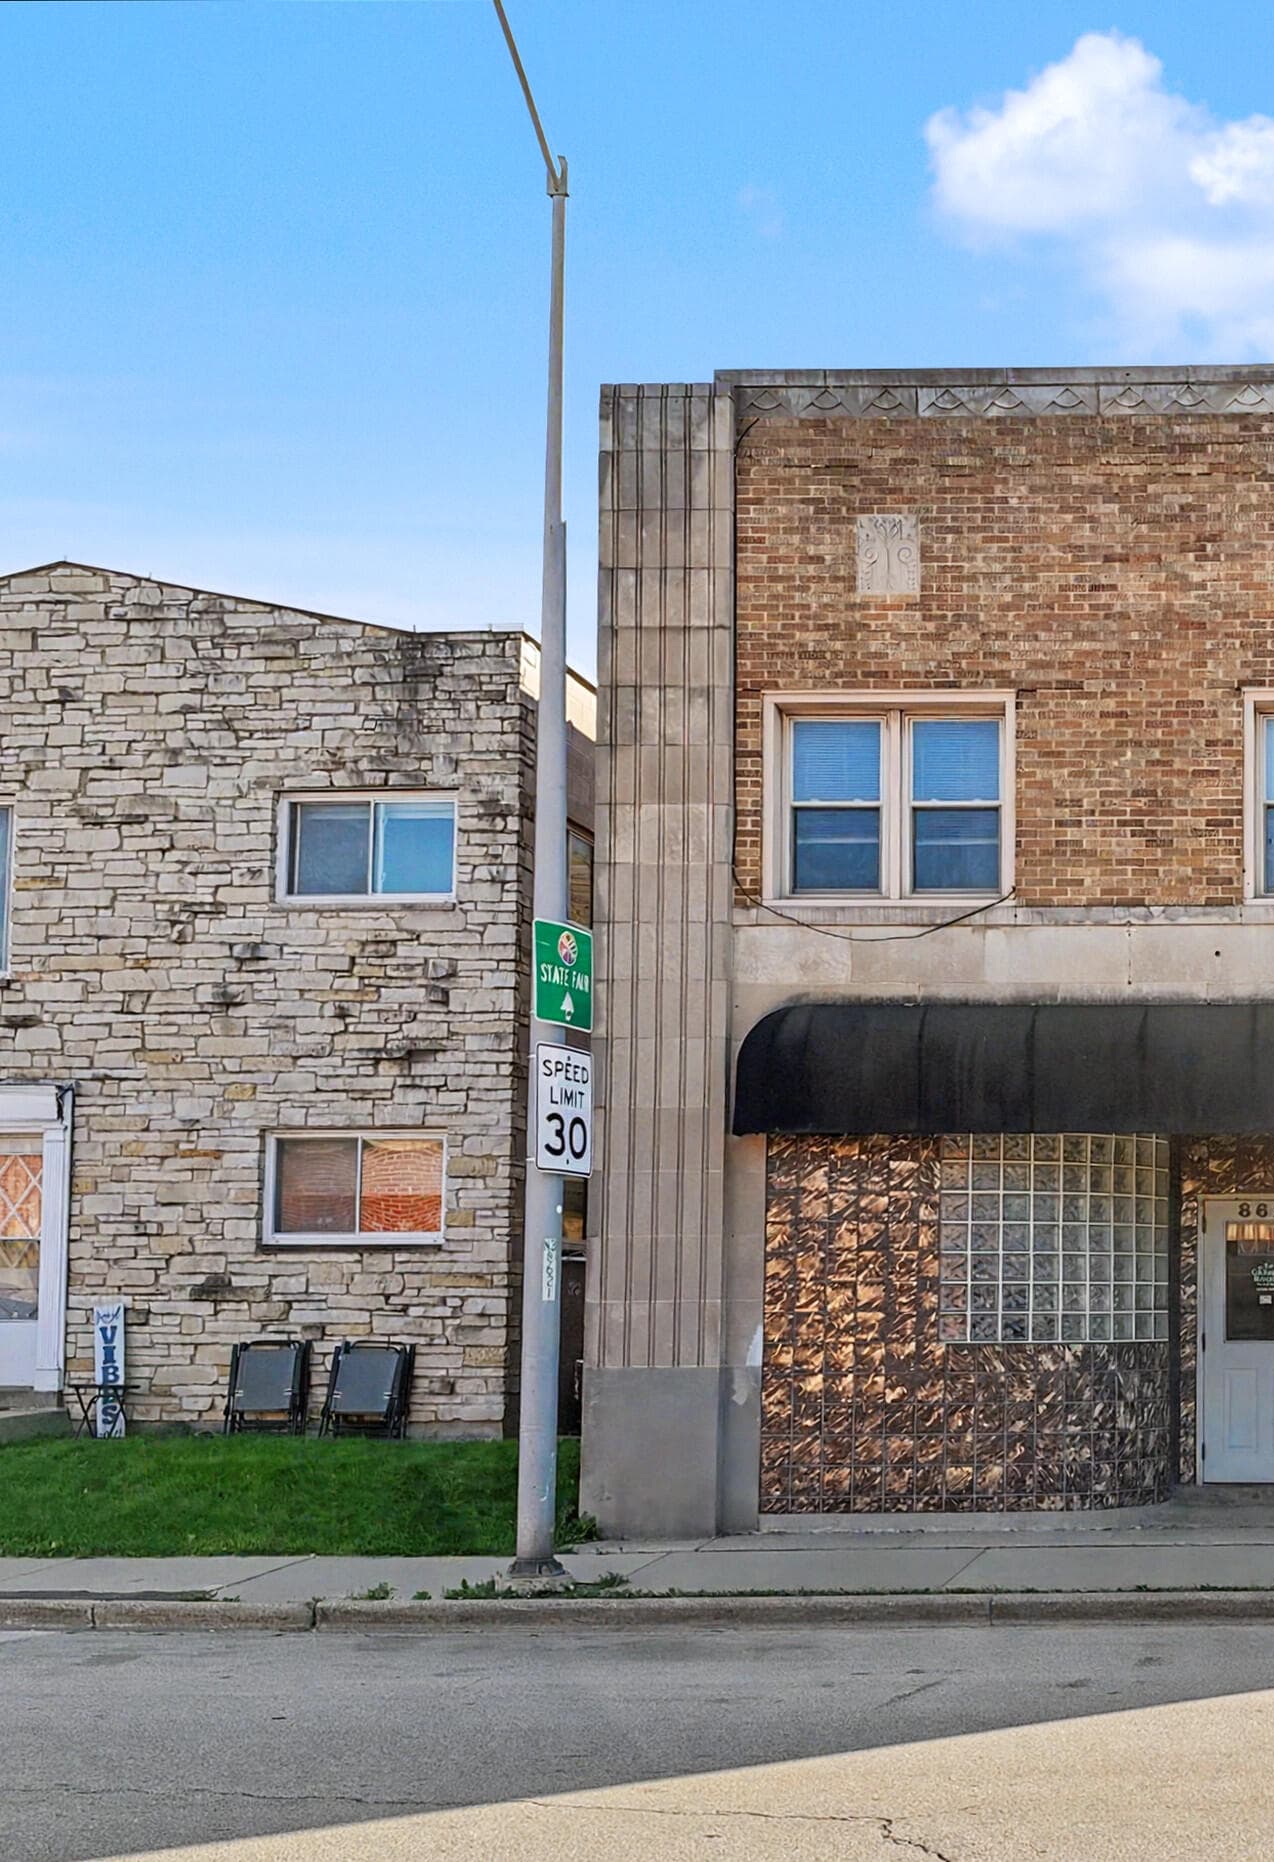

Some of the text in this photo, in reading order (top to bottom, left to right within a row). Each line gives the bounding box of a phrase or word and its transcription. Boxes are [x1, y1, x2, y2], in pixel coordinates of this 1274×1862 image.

[540, 962, 570, 987] STATE
[543, 1059, 589, 1084] SPEED
[550, 1086, 585, 1109] LIMIT
[544, 1112, 587, 1159] 30
